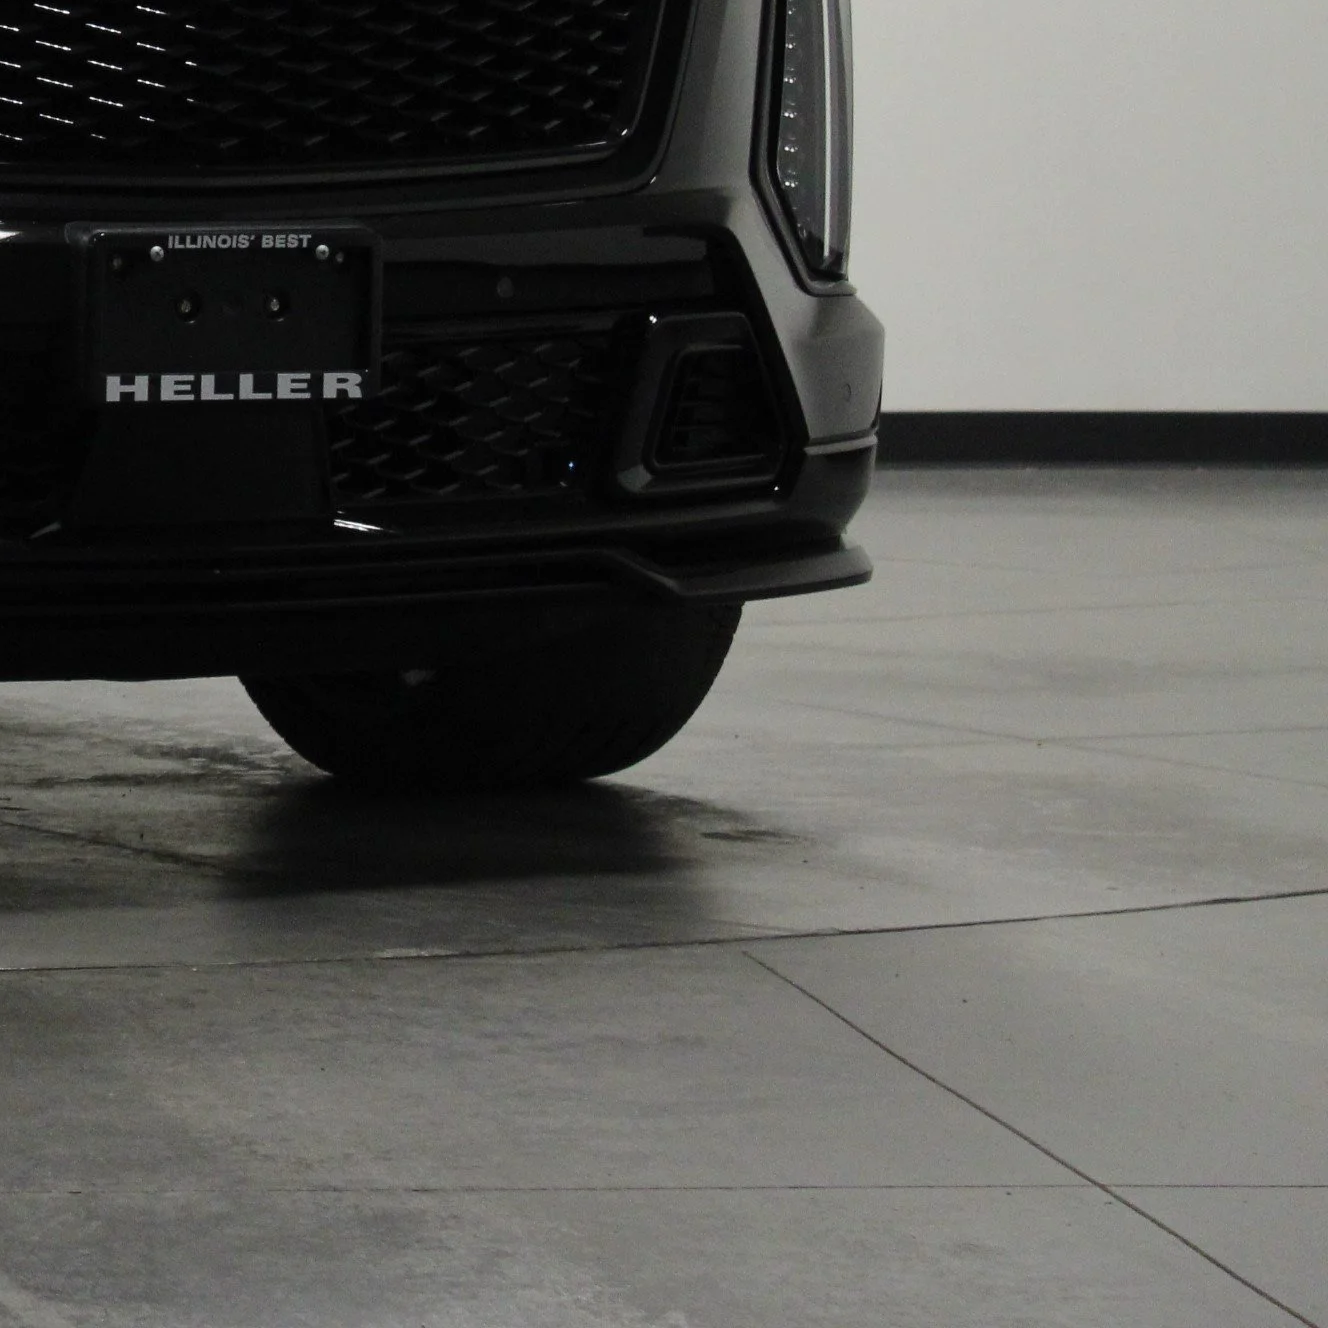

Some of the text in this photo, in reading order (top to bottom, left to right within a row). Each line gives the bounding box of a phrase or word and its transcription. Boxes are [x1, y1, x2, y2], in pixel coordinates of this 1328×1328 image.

[167, 234, 312, 249] ILLINOIS' BEST
[106, 372, 362, 402] HELLER
